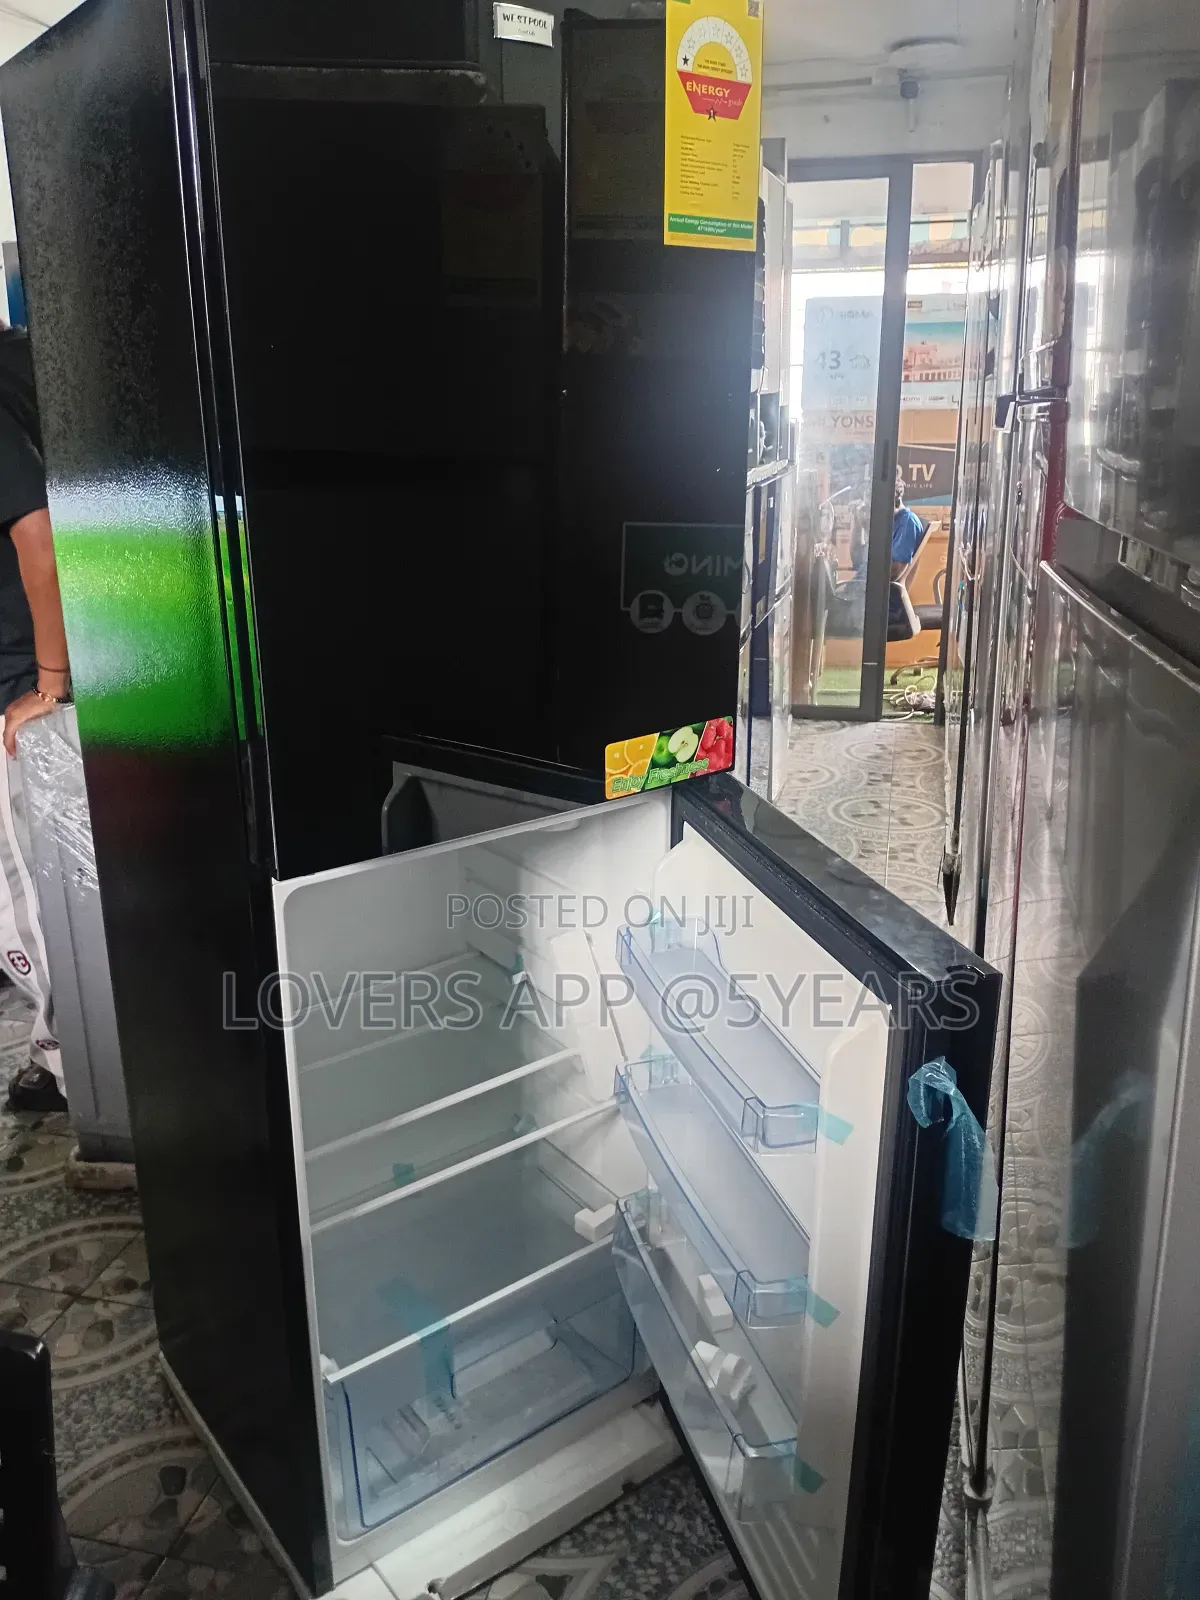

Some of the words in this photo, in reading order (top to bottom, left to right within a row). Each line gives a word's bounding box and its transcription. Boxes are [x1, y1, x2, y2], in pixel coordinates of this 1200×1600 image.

[502, 13, 547, 29] WESTPOOL
[686, 80, 731, 98] ENERGY
[908, 463, 936, 481] TV
[611, 774, 647, 793] Enjoy
